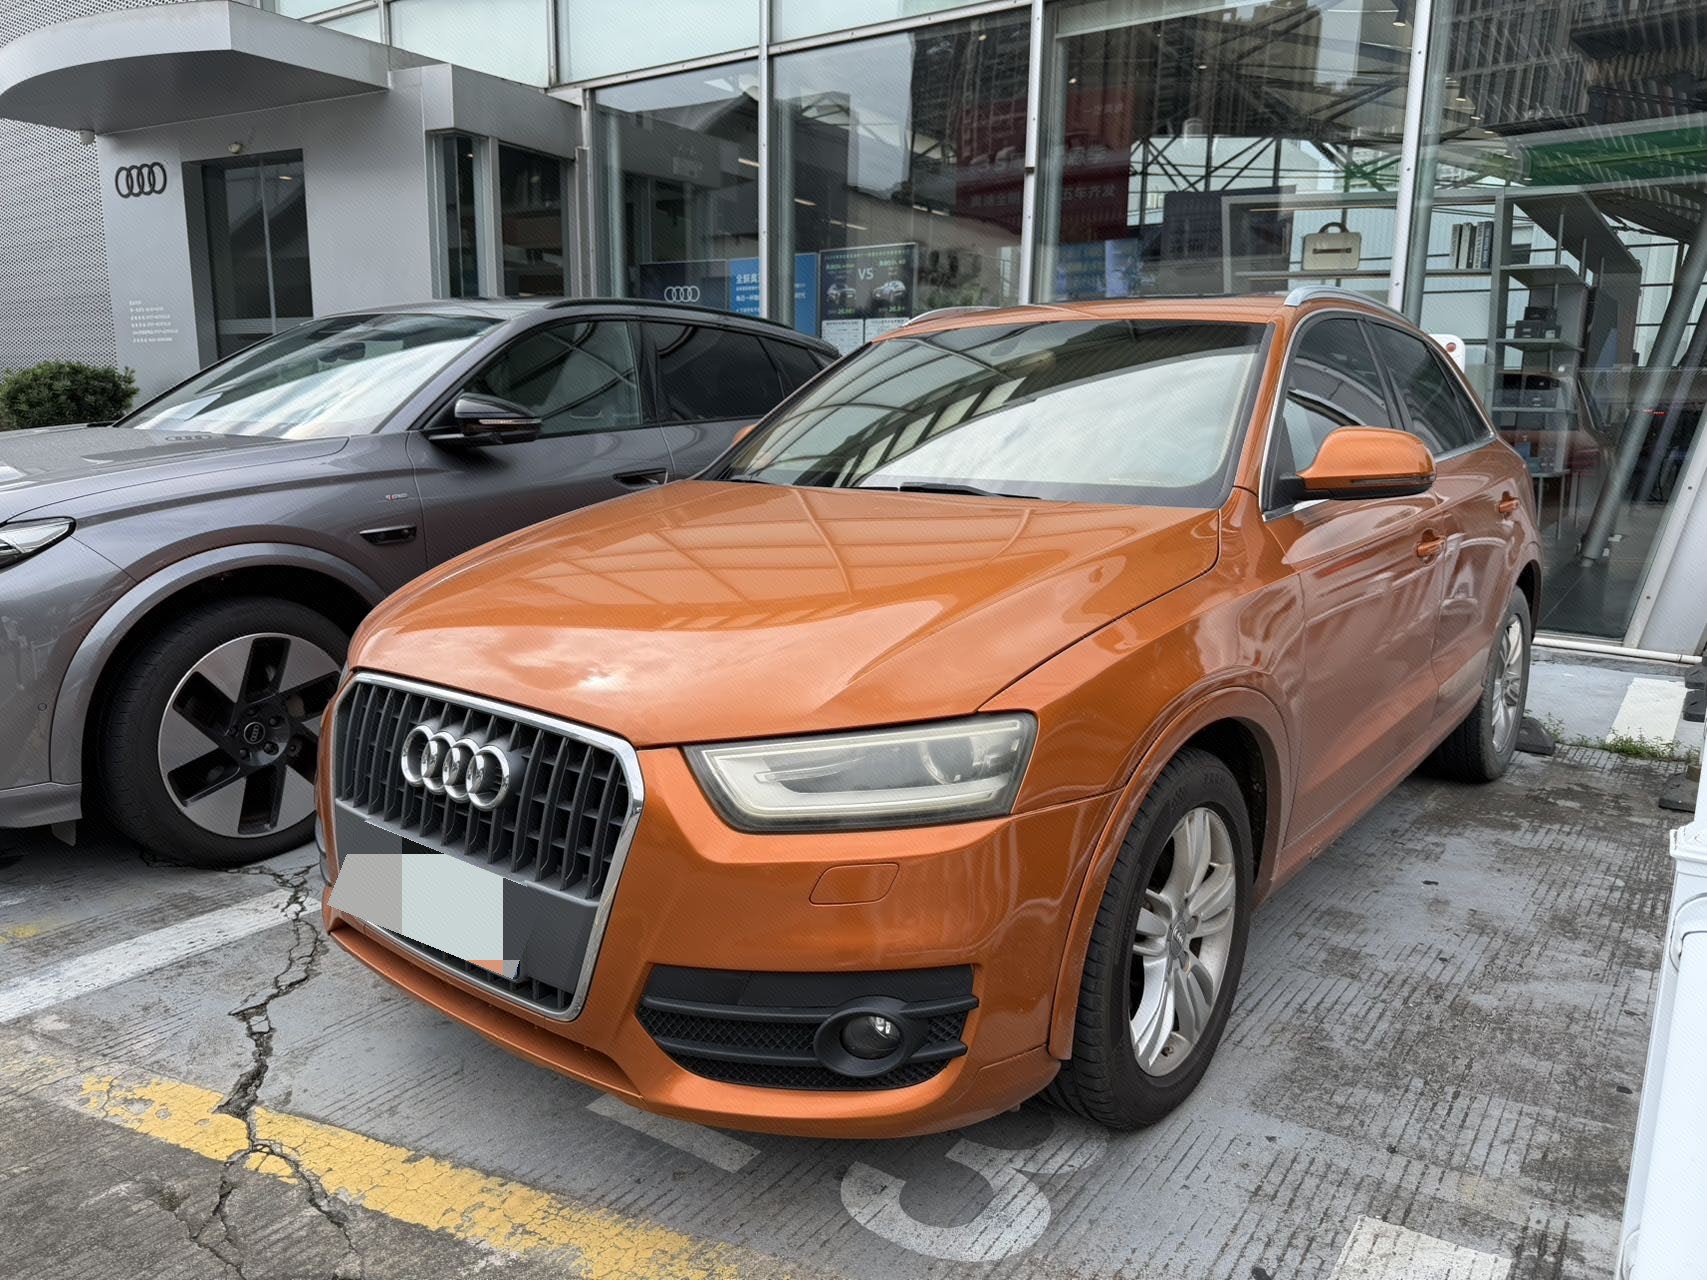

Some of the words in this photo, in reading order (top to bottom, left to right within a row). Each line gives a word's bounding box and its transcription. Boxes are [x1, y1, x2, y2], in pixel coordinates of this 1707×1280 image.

[735, 273, 760, 285] 全新奥
[858, 267, 874, 280] VS
